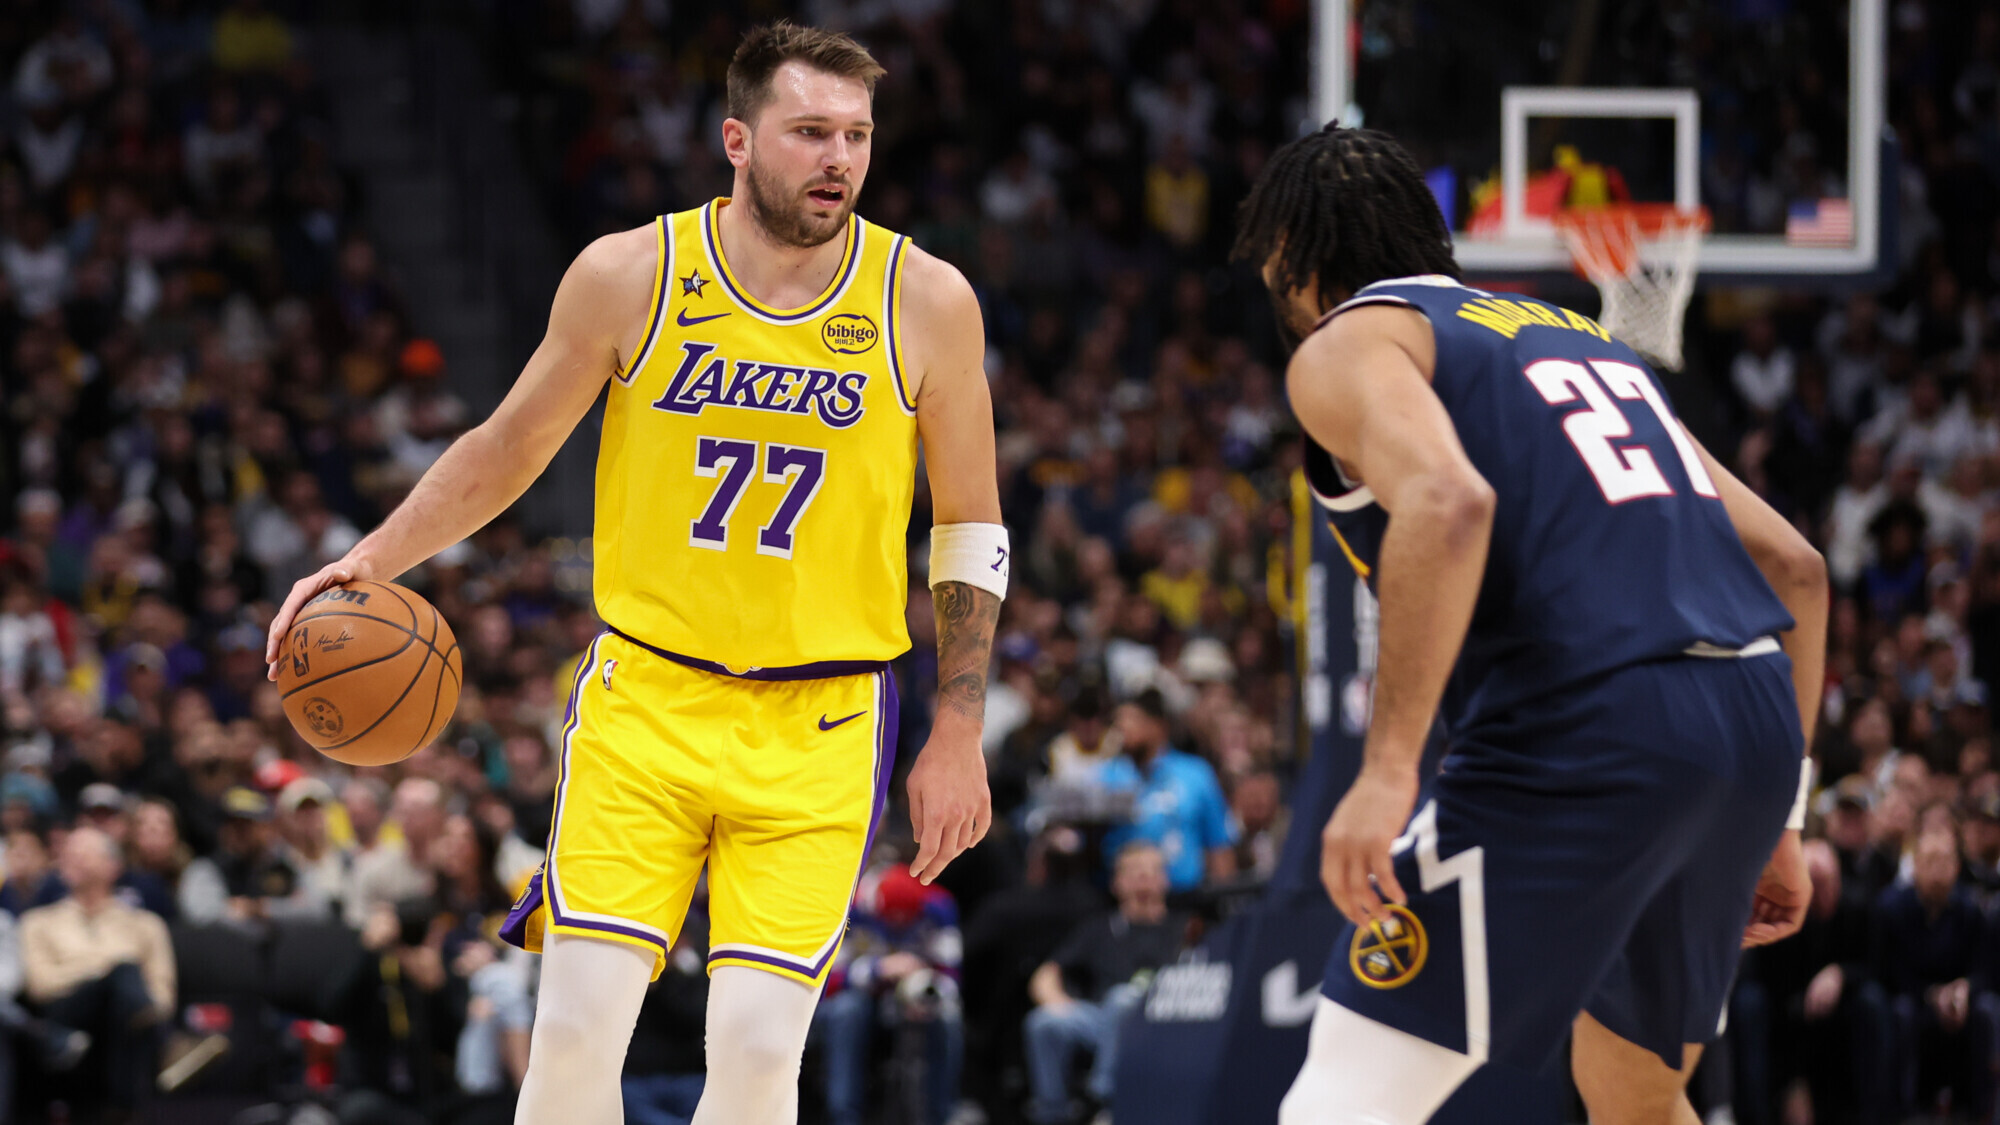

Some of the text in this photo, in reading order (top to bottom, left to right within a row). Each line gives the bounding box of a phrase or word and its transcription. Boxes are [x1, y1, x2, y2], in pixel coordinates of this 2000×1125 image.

[651, 340, 870, 429] LAKERS
[826, 323, 875, 343] bibigo
[1522, 357, 1722, 506] 27
[689, 435, 828, 561] 77
